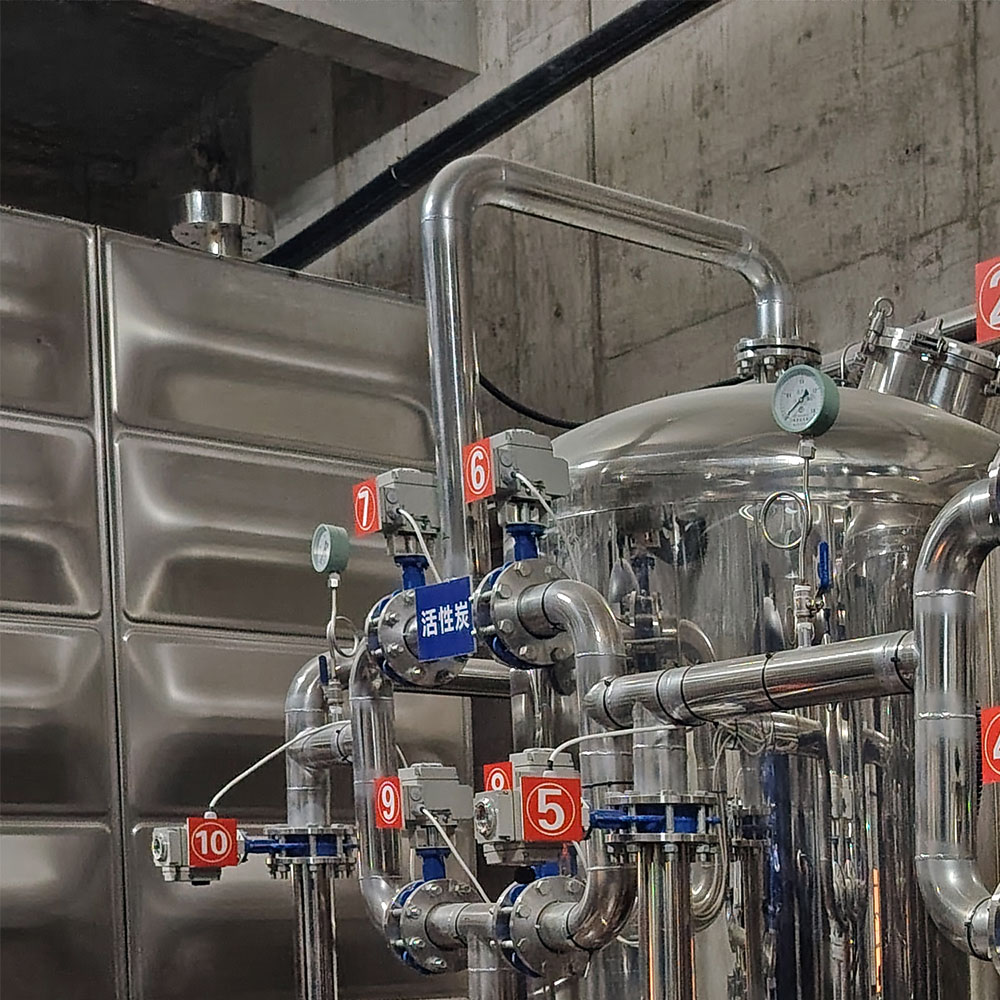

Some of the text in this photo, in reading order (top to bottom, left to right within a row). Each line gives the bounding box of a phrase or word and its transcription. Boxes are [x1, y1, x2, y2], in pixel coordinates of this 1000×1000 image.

[469, 450, 486, 491] 6
[357, 490, 369, 526] 7
[421, 601, 470, 637] 活性炭
[382, 790, 394, 819] 9
[538, 788, 565, 831] 5
[195, 831, 226, 855] 10
